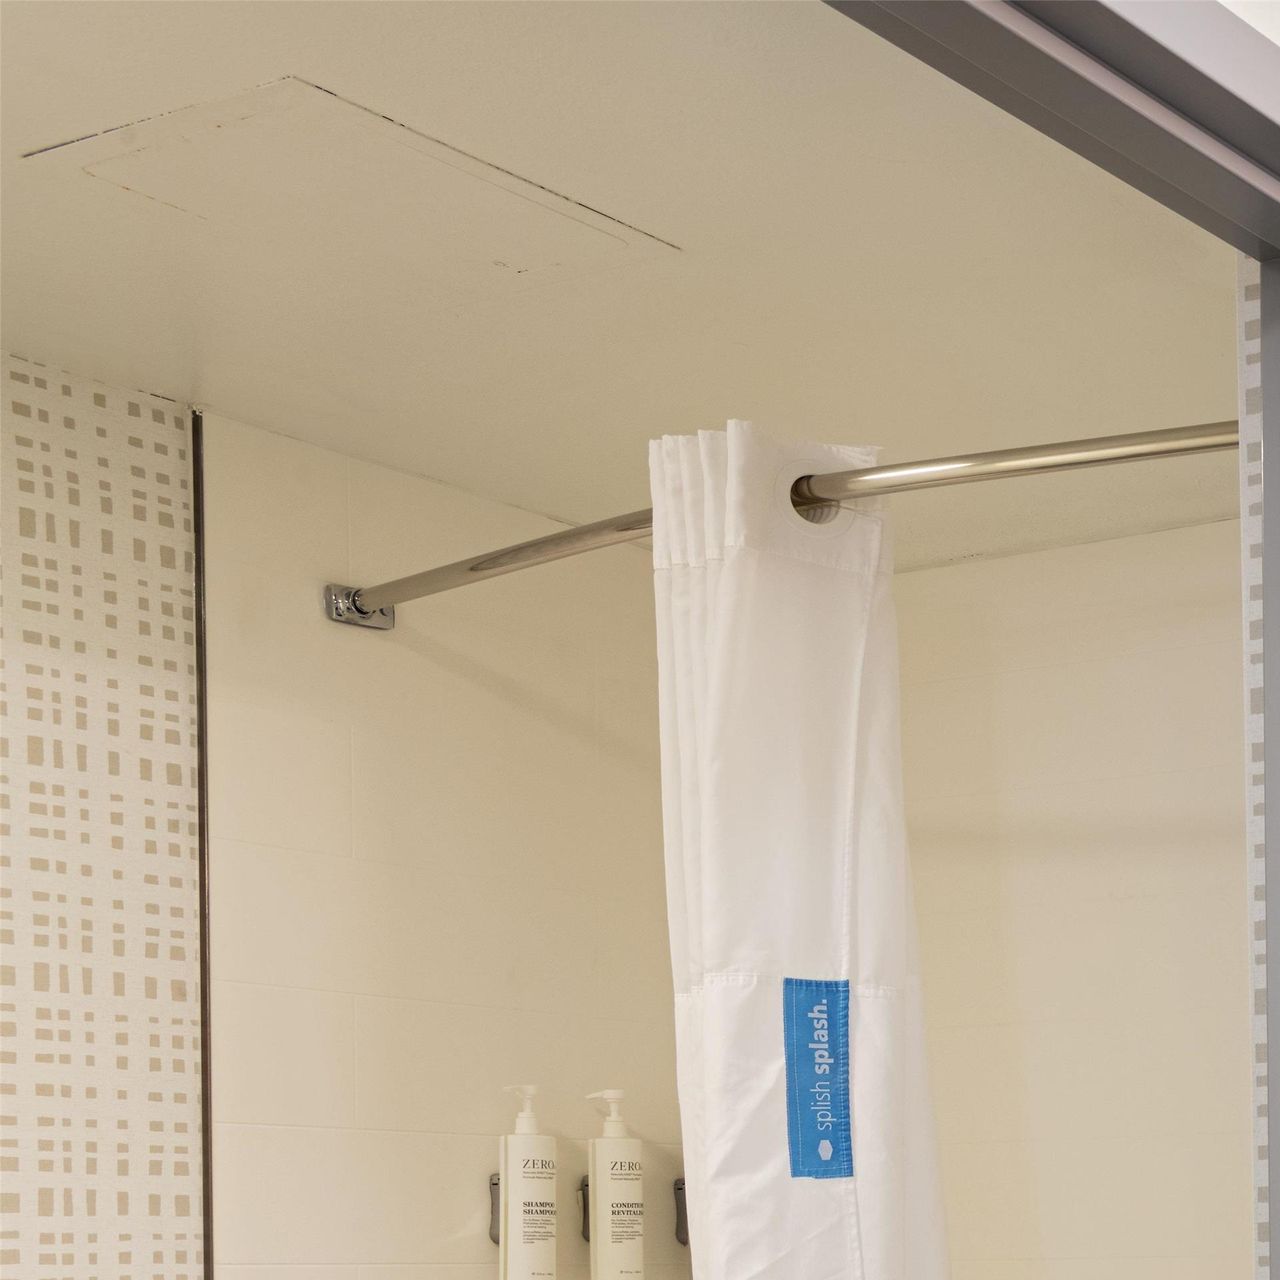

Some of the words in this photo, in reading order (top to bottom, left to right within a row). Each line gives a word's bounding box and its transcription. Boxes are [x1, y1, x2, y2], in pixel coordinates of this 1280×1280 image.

[808, 999, 834, 1075] splash.
[810, 1081, 837, 1131] splish
[522, 1159, 555, 1170] ZERO
[610, 1161, 641, 1171] ZERO
